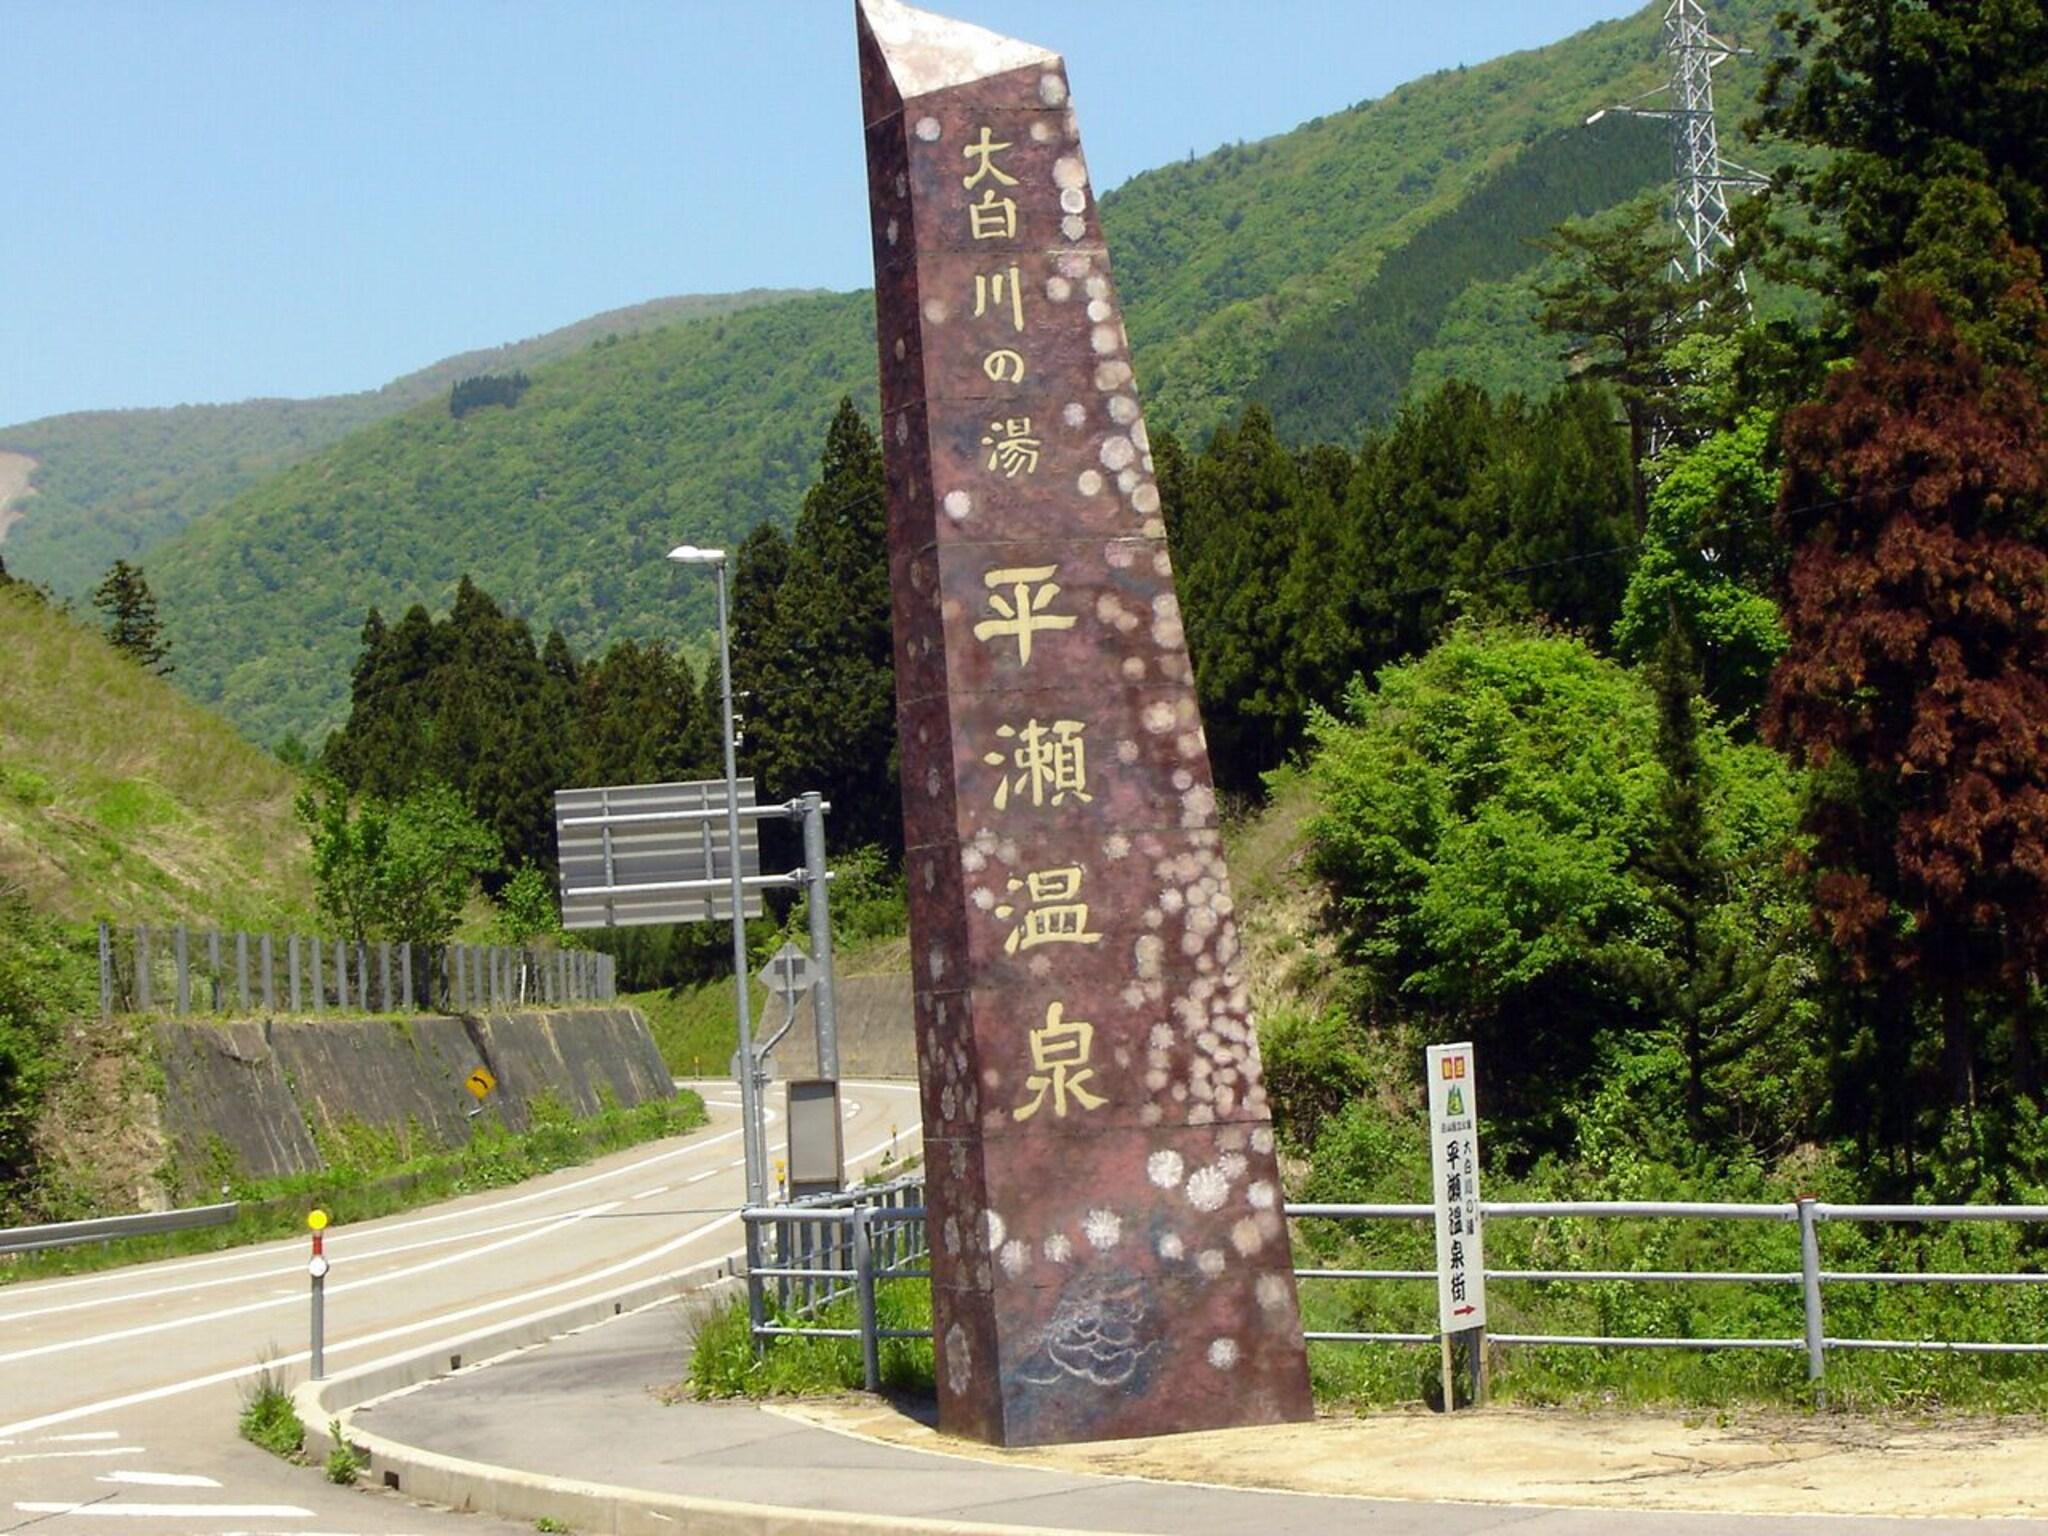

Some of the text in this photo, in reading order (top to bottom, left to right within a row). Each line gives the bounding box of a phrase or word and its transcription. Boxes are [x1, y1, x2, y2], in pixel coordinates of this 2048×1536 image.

[963, 127, 1041, 478] 大白川の湯
[974, 564, 1108, 1121] 平瀬温泉
